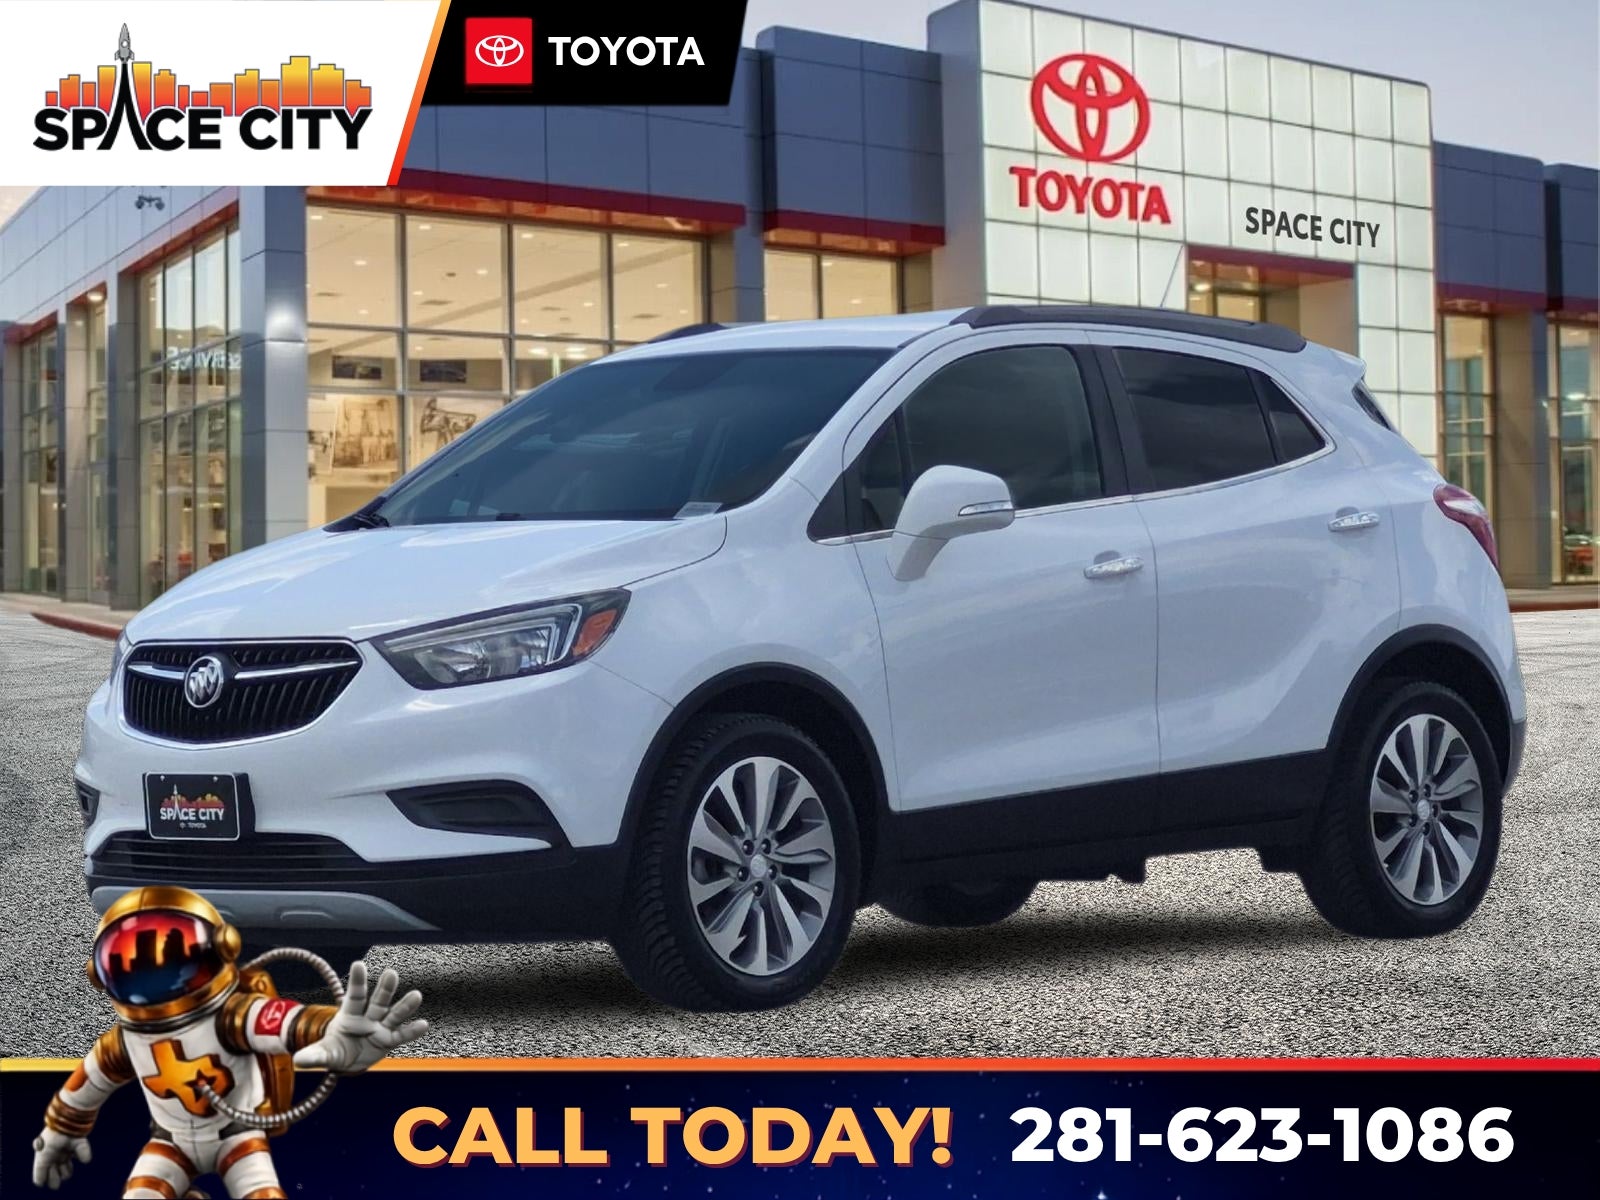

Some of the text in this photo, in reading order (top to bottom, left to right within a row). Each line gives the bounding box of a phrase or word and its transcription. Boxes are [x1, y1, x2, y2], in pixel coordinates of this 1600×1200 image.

[1008, 166, 1171, 224] TOYOTA
[1244, 206, 1381, 248] SPACE CITY
[159, 805, 225, 821] SPACE CITY
